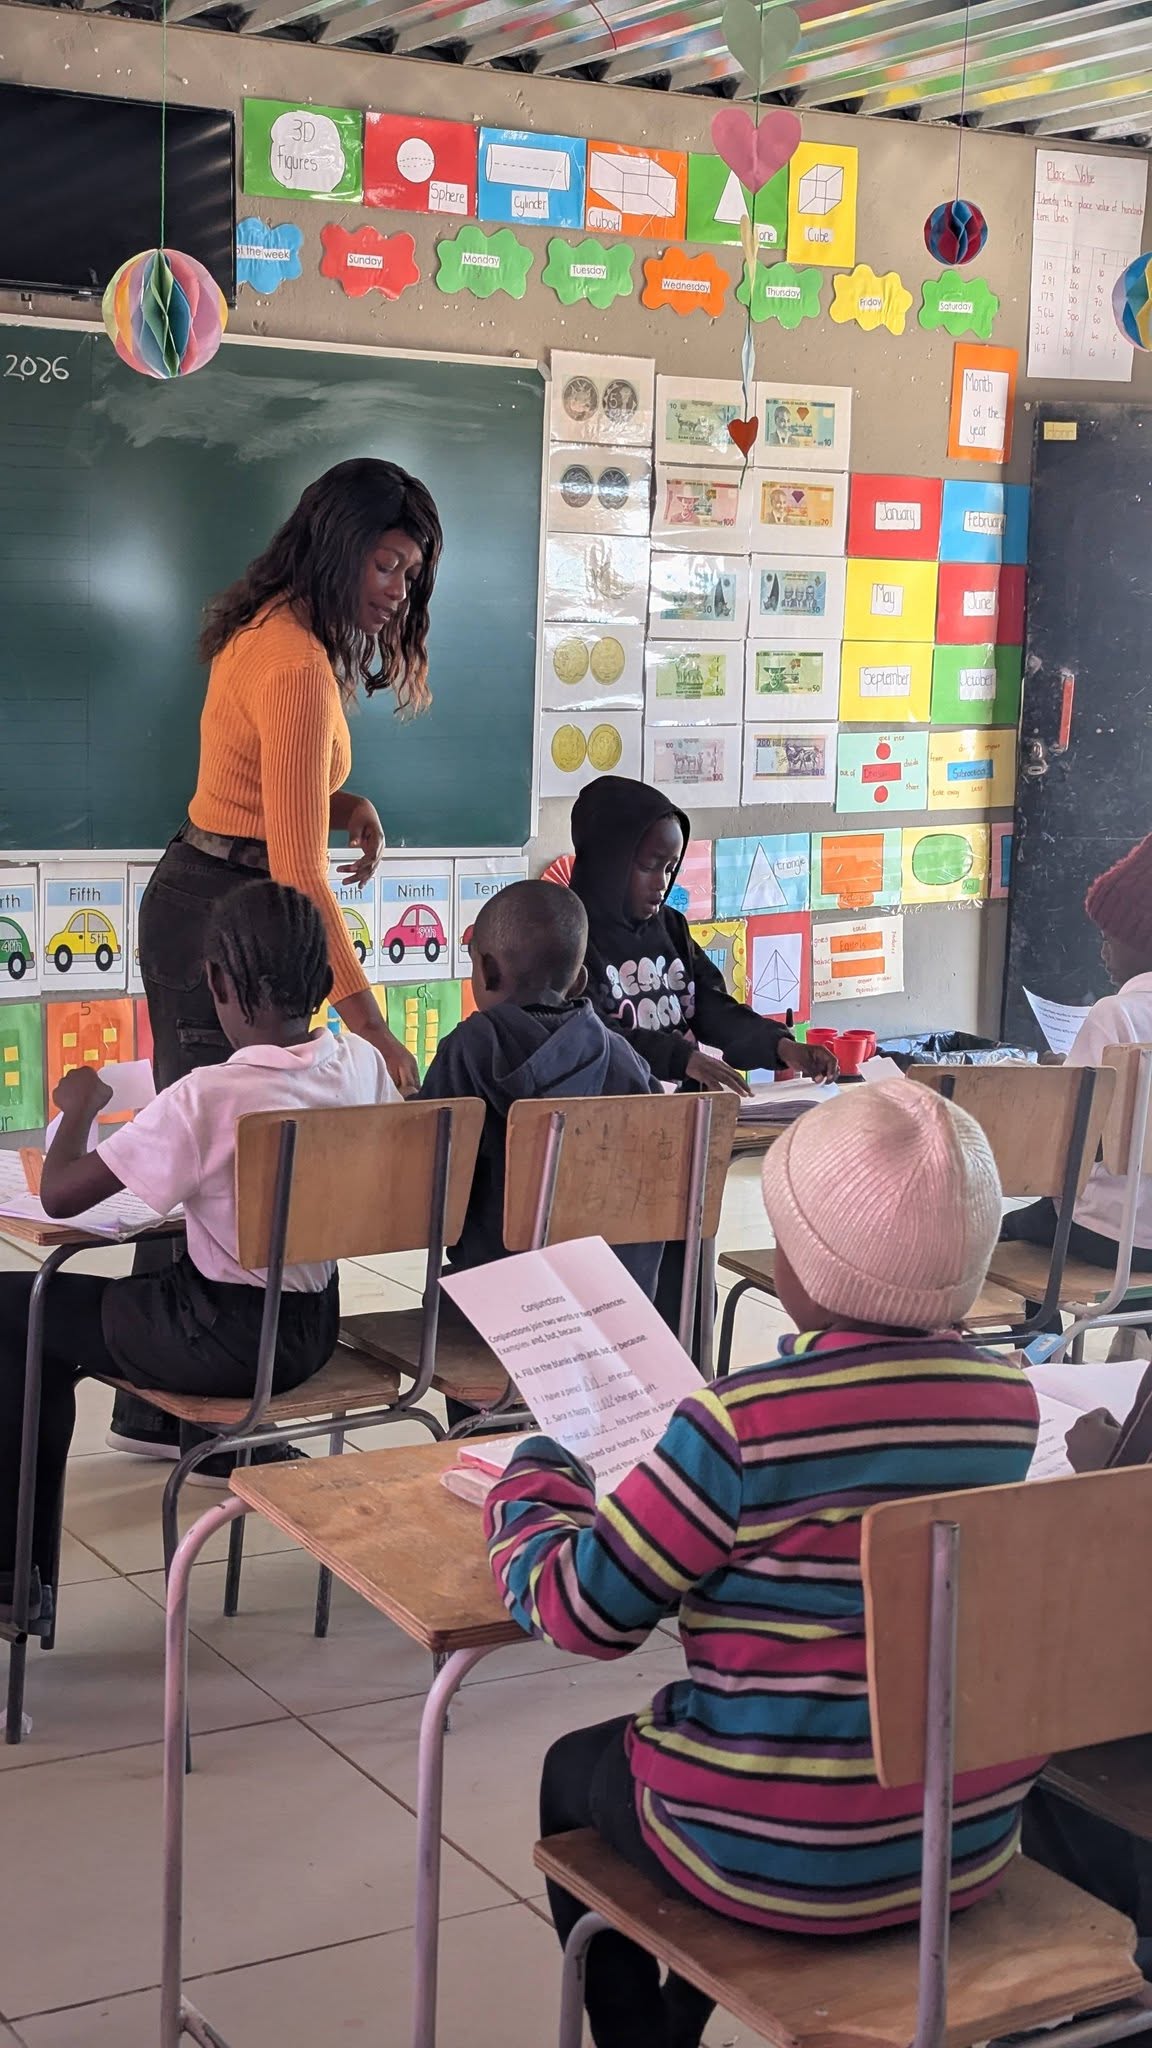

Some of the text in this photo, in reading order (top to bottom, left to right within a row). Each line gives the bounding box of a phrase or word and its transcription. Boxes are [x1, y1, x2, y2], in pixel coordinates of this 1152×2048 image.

[292, 119, 315, 142] 3D
[430, 183, 465, 209] Sphere
[514, 192, 547, 217] Cylinder
[588, 211, 620, 231] Cuboid
[759, 231, 774, 242] one
[807, 228, 829, 243] Cube
[264, 250, 290, 259] week
[348, 254, 382, 268] Sunday
[463, 254, 500, 267] Monday
[572, 265, 607, 276] Tuesday
[663, 279, 711, 293] Wednesday
[767, 287, 801, 299] Thursday
[859, 298, 882, 308] Friday
[940, 302, 972, 312] Saturday
[3, 354, 70, 384] 2026
[965, 372, 993, 393] Month
[973, 405, 1000, 419] of the
[969, 425, 987, 443] year
[880, 503, 916, 530] January
[875, 584, 895, 613] May
[967, 592, 992, 610] June
[864, 668, 909, 693] September
[960, 669, 994, 687] October
[776, 855, 806, 875] triangle
[69, 887, 101, 902] Fifth
[397, 884, 435, 898] Ninth
[89, 933, 109, 944] 5th
[417, 926, 437, 938] 9th
[1, 940, 23, 952] 4th
[80, 1001, 91, 1016] 5
[521, 1295, 565, 1312] Conjunctions
[488, 1325, 531, 1342] Conjunctions
[529, 1321, 544, 1332] join
[542, 1318, 556, 1326] two
[555, 1313, 574, 1322] words
[530, 1334, 546, 1345] and,
[556, 1326, 581, 1336] because
[521, 1367, 533, 1376] Fill
[539, 1363, 552, 1371] the
[550, 1357, 572, 1368] blanks
[572, 1352, 587, 1362] with
[610, 1344, 618, 1352] or
[614, 1394, 627, 1403] she
[627, 1389, 639, 1400] got
[625, 1409, 650, 1422] brother
[604, 1444, 616, 1453] our
